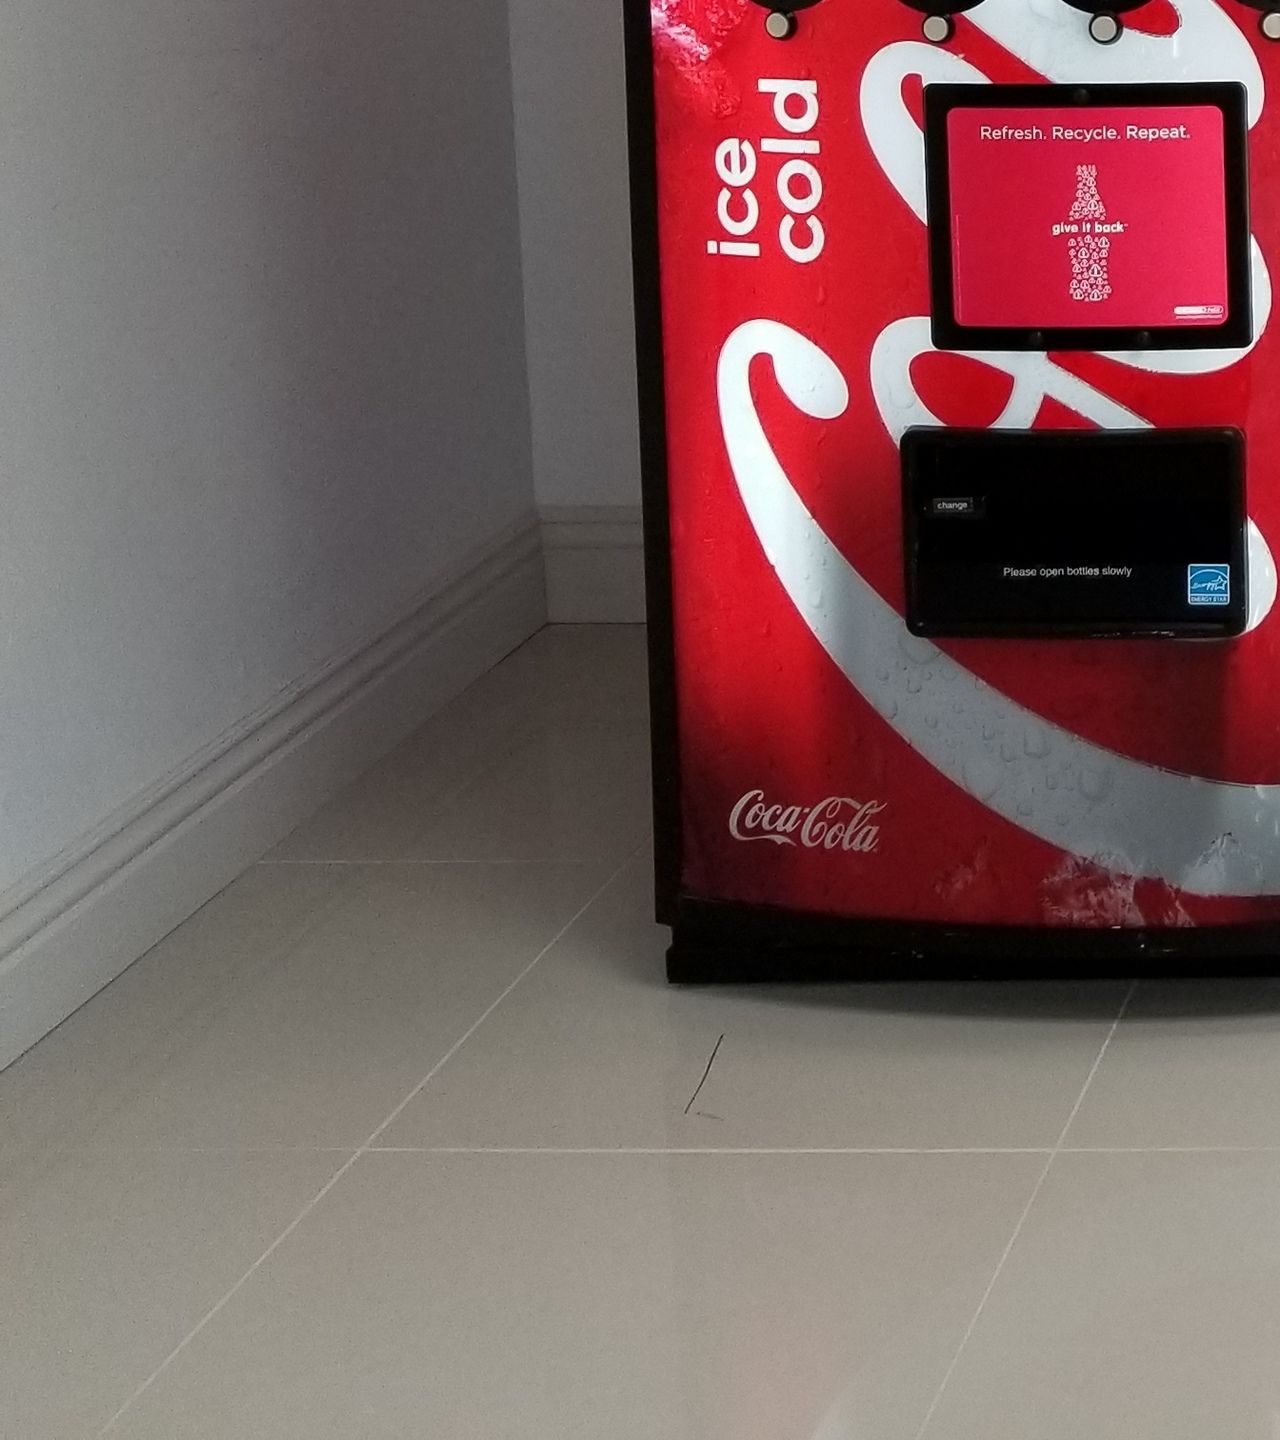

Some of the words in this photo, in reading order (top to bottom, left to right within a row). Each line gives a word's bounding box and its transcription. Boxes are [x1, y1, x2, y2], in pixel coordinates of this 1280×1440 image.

[980, 126, 1046, 140] Refresh.
[1052, 126, 1121, 142] Recycle.
[1126, 125, 1190, 141] Repeat.
[758, 78, 825, 263] cold
[707, 137, 760, 257] ice
[1052, 222, 1079, 235] give
[1082, 221, 1091, 233] it
[937, 501, 968, 510] change
[1003, 567, 1037, 577] Please
[1039, 568, 1064, 578] open
[1066, 566, 1100, 576] bottles
[1102, 566, 1132, 577] slowly
[728, 789, 887, 853] Coca-Cola
